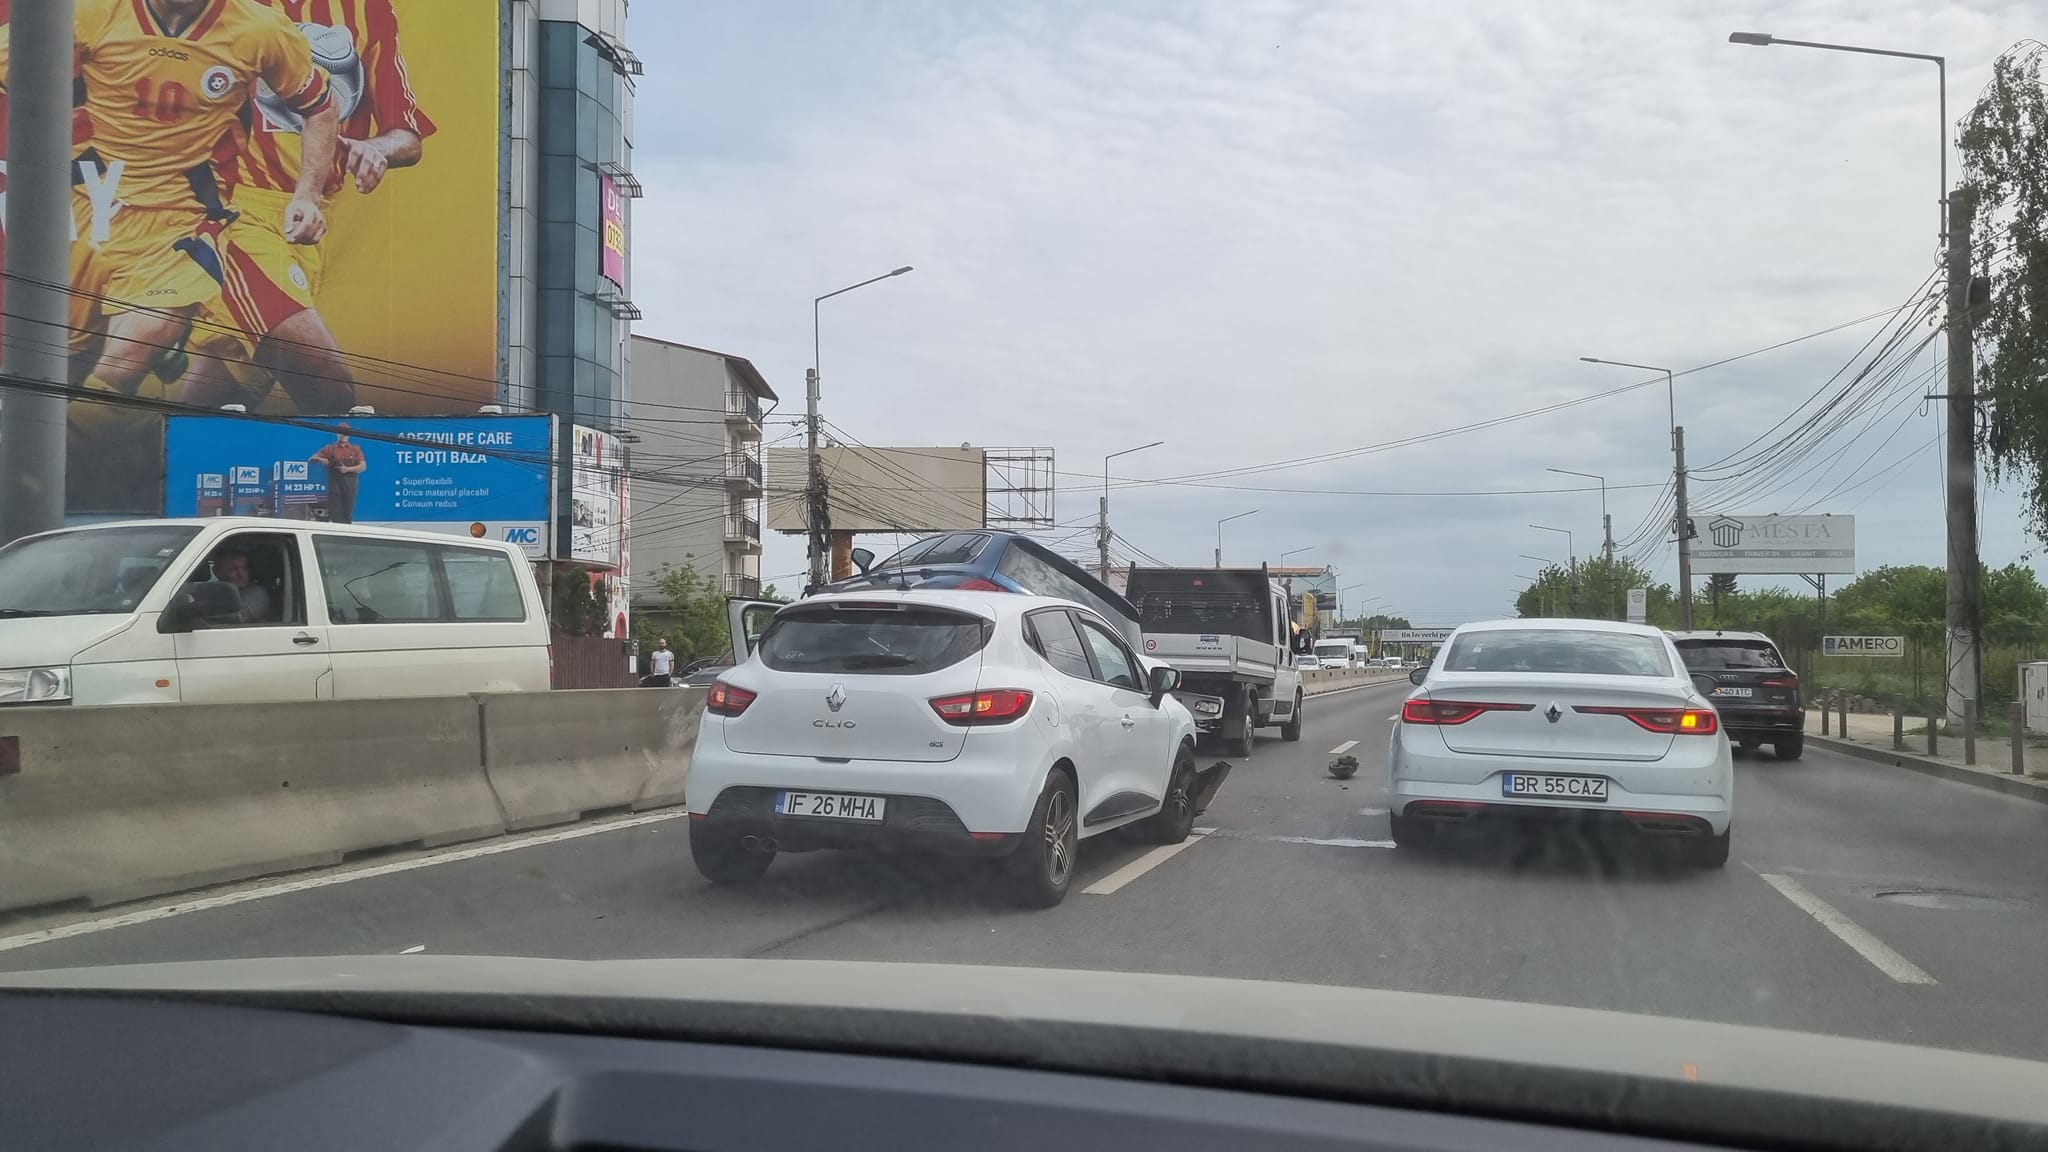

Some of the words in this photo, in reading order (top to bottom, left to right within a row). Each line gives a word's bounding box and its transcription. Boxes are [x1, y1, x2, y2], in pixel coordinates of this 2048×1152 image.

[149, 48, 189, 62] adidas
[134, 78, 186, 124] 10
[458, 432, 473, 445] PE
[478, 432, 512, 445] CARE
[396, 451, 412, 463] TE
[450, 451, 487, 464] BAZA
[288, 464, 305, 473] MC
[402, 488, 423, 497] Orice
[425, 488, 456, 497] material
[458, 488, 489, 498] placabil
[402, 499, 433, 508] Consum
[435, 499, 457, 508] redus
[504, 528, 537, 543] MC
[1751, 523, 1832, 539] MESTA
[1837, 637, 1898, 650] AMERO
[812, 719, 856, 729] CLIO
[1513, 776, 1538, 793] BR
[1545, 777, 1565, 793] 55
[1568, 778, 1604, 796] CAZ
[788, 794, 807, 814] IF
[812, 795, 834, 815] 26
[838, 796, 875, 819] MHA
